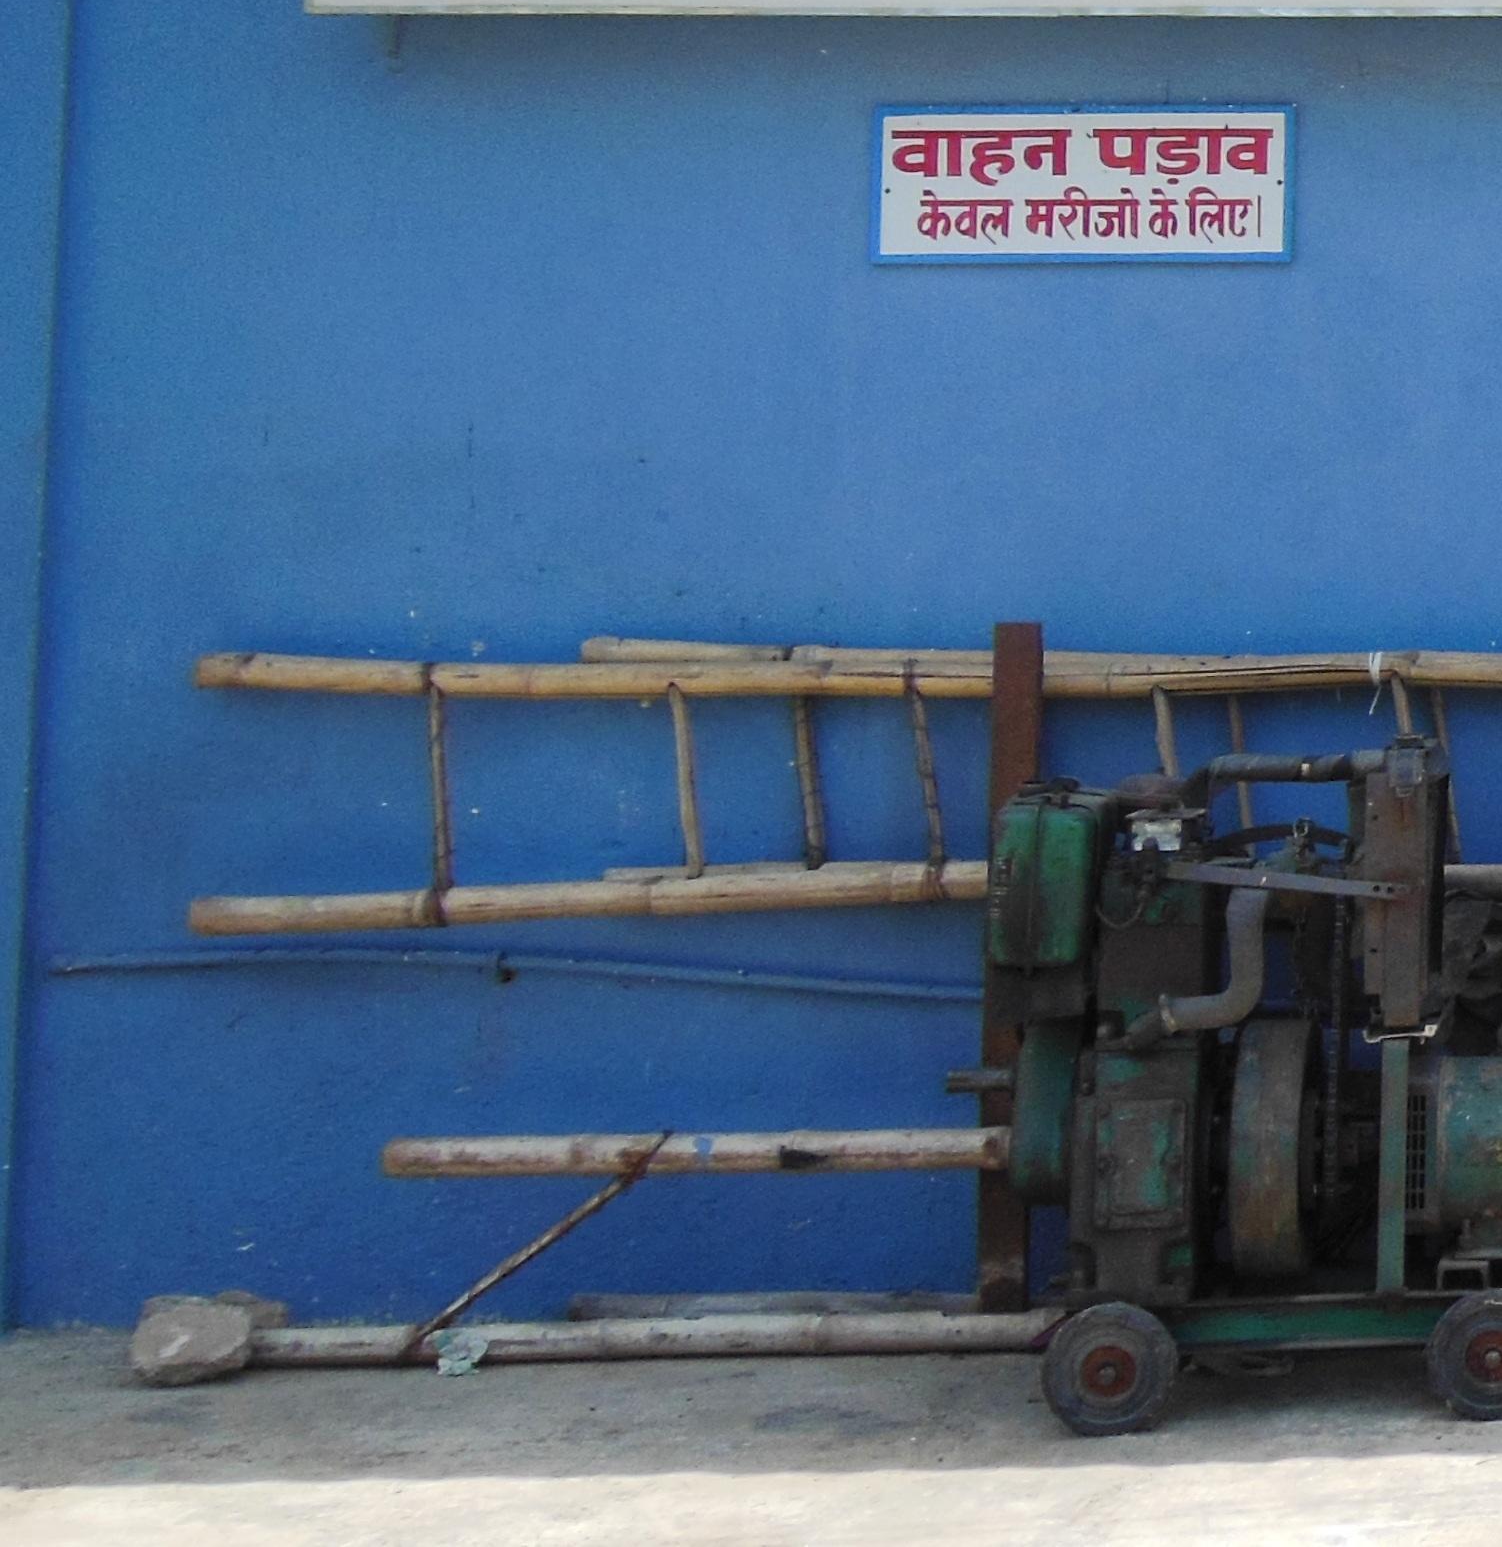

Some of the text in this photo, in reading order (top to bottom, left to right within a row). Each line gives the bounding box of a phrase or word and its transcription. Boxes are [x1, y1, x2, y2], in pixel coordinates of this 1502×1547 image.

[891, 128, 1274, 186] वाहन पड़ाव
[916, 189, 1015, 245] केवल
[1148, 187, 1180, 240] के
